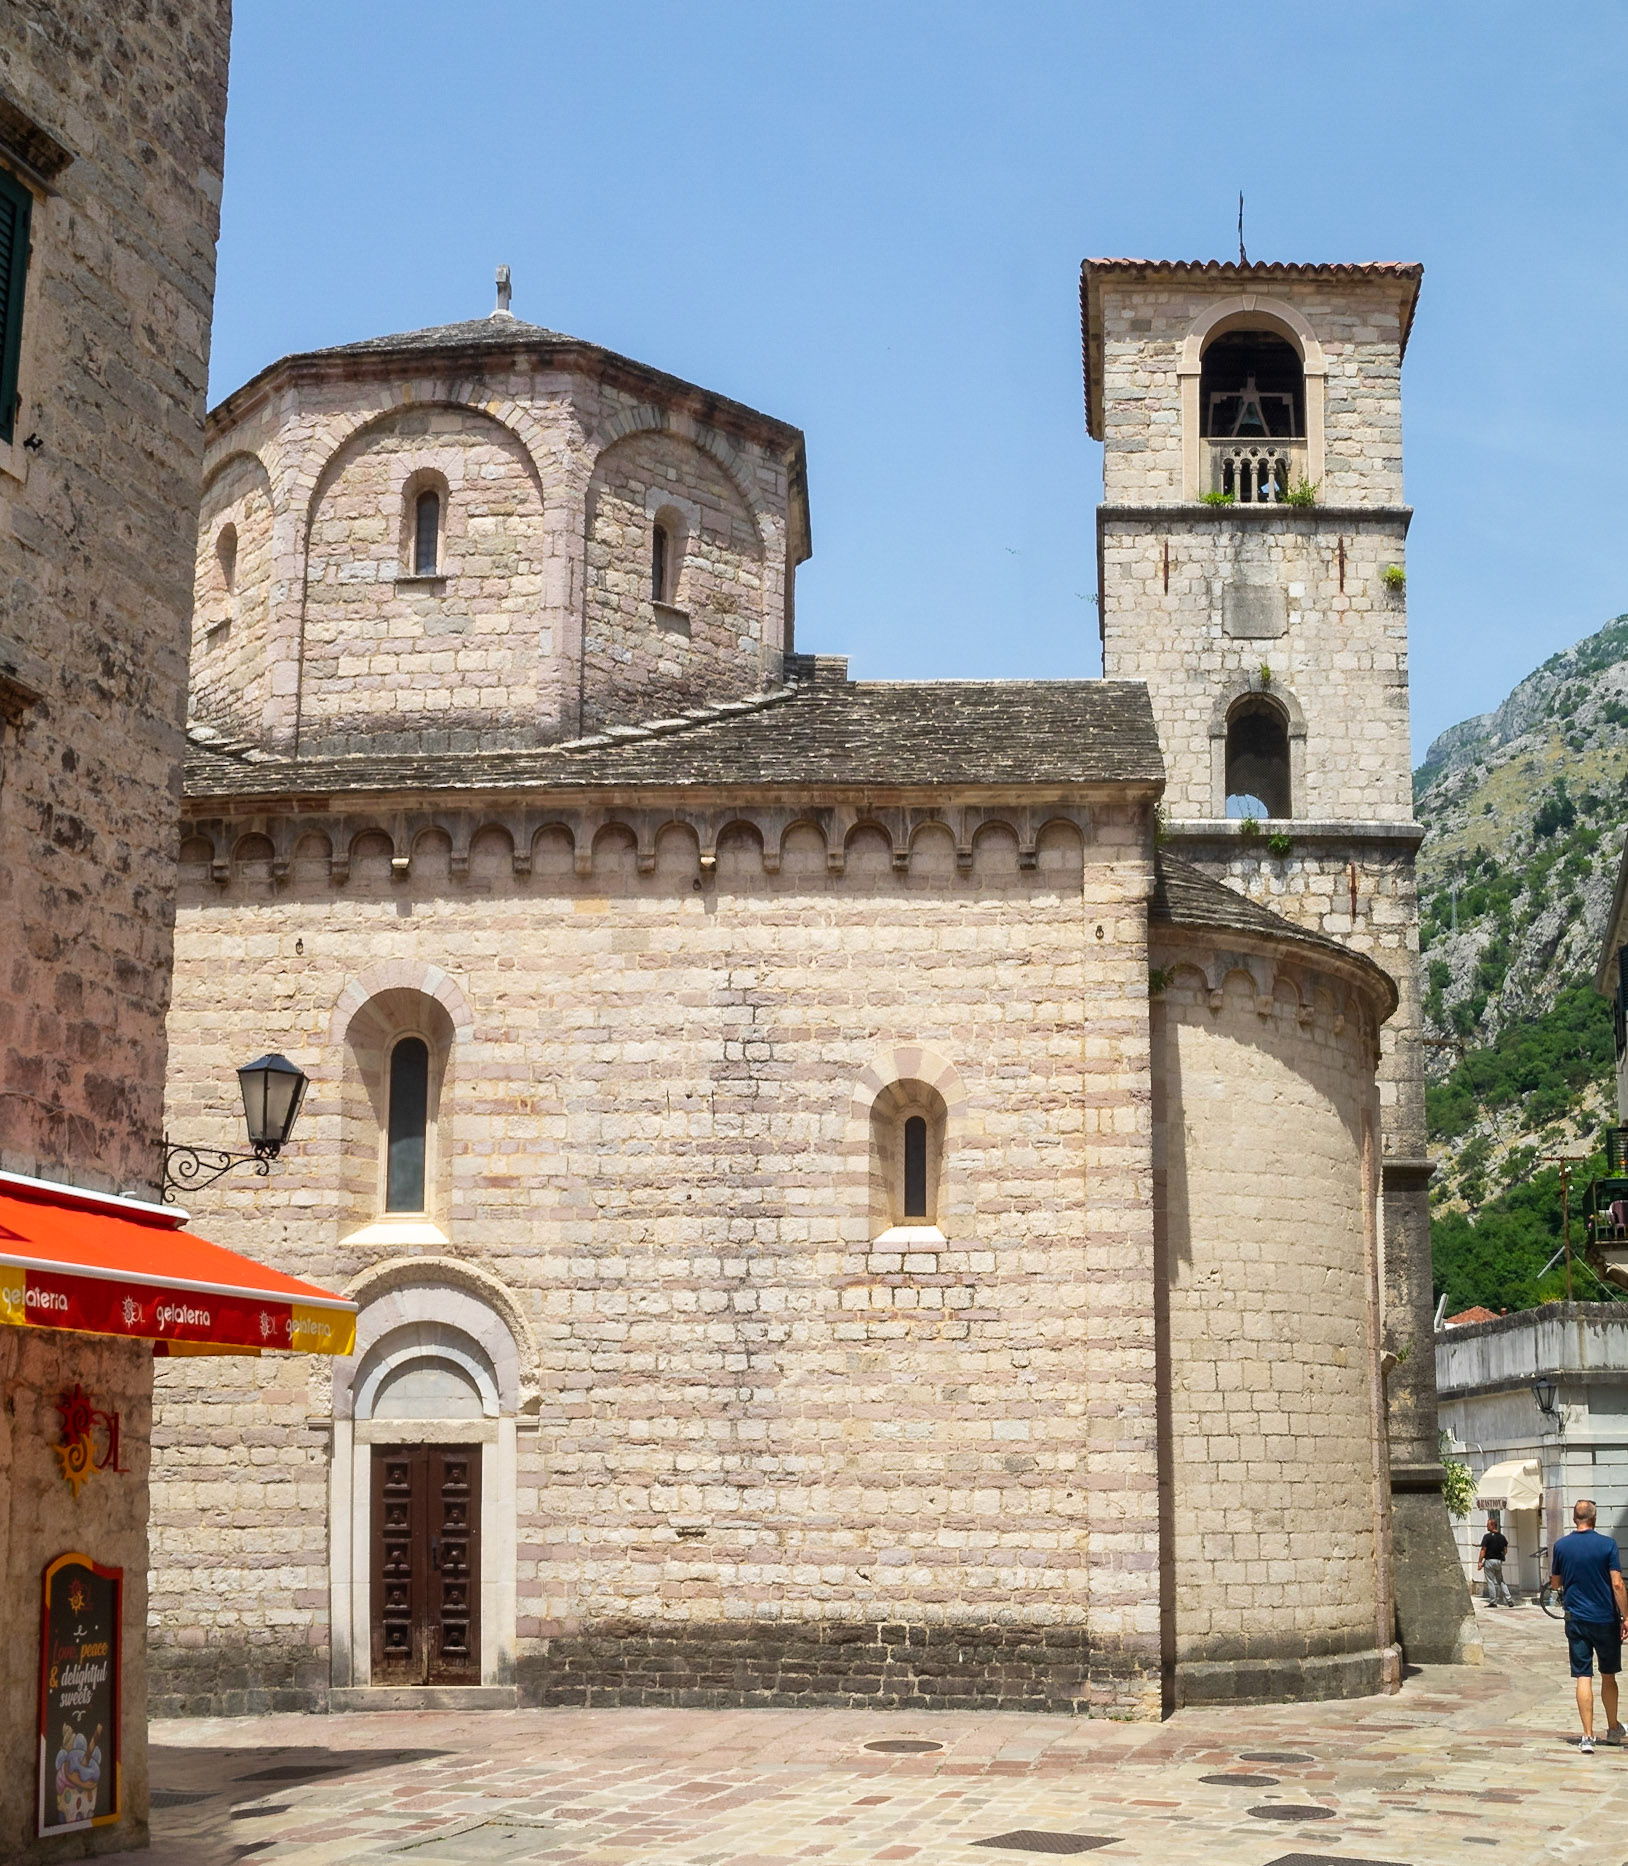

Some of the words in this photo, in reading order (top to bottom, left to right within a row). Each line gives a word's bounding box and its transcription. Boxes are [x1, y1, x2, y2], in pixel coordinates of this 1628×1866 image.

[2, 1284, 68, 1314] gelateria
[156, 1303, 211, 1332] gelateria
[285, 1316, 331, 1342] gelateria
[80, 1642, 108, 1665] peace
[50, 1665, 59, 1688] &
[60, 1660, 107, 1692] delightful
[59, 1685, 92, 1708] sweets
